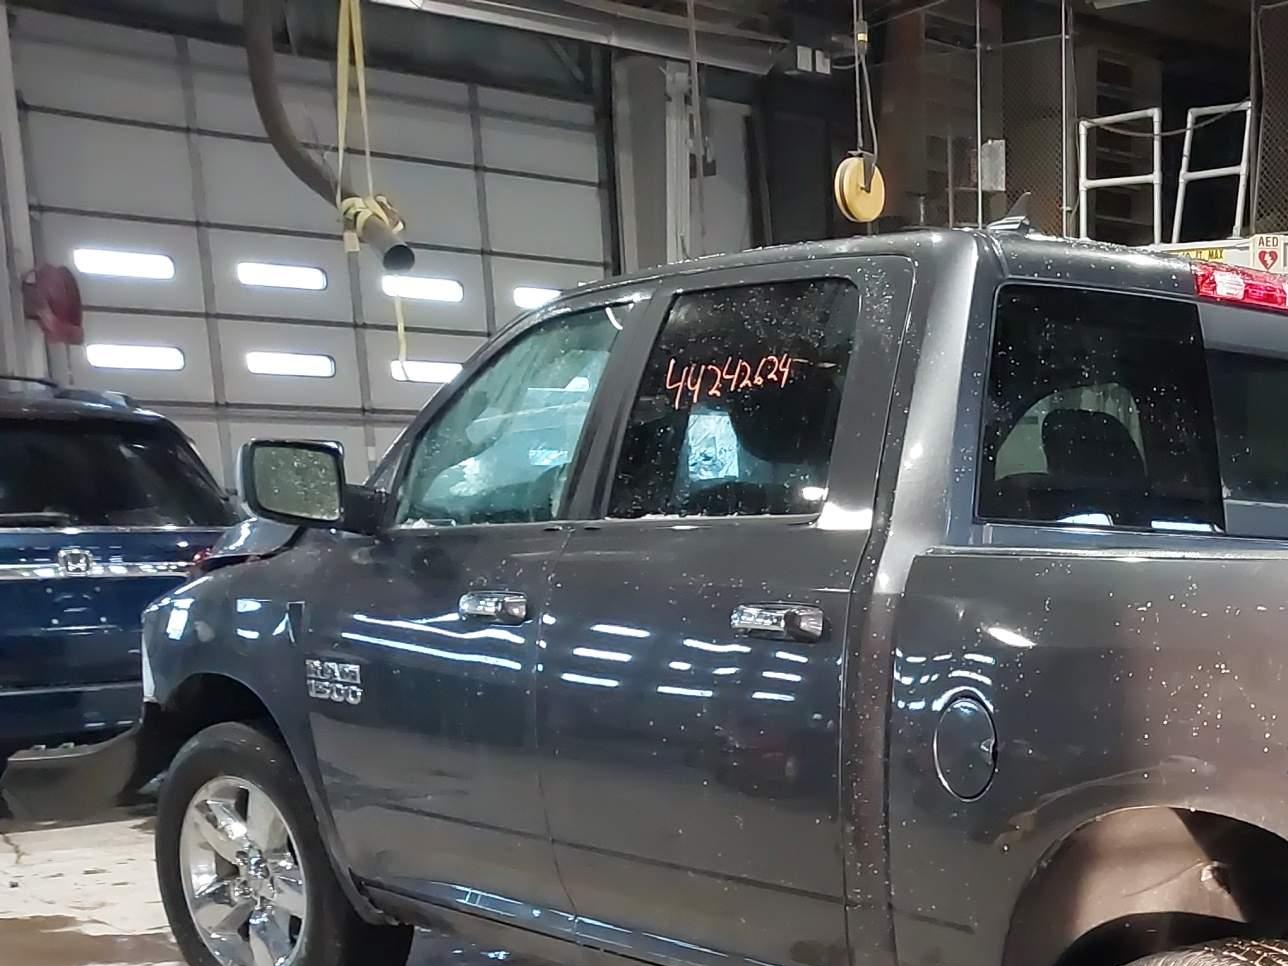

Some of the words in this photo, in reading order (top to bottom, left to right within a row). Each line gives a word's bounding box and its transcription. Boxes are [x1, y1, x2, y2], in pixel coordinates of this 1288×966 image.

[1258, 236, 1279, 247] AED
[1208, 249, 1223, 260] MAX
[666, 353, 792, 410] 44242624
[305, 659, 361, 684] RAM
[307, 679, 363, 705] 1500
